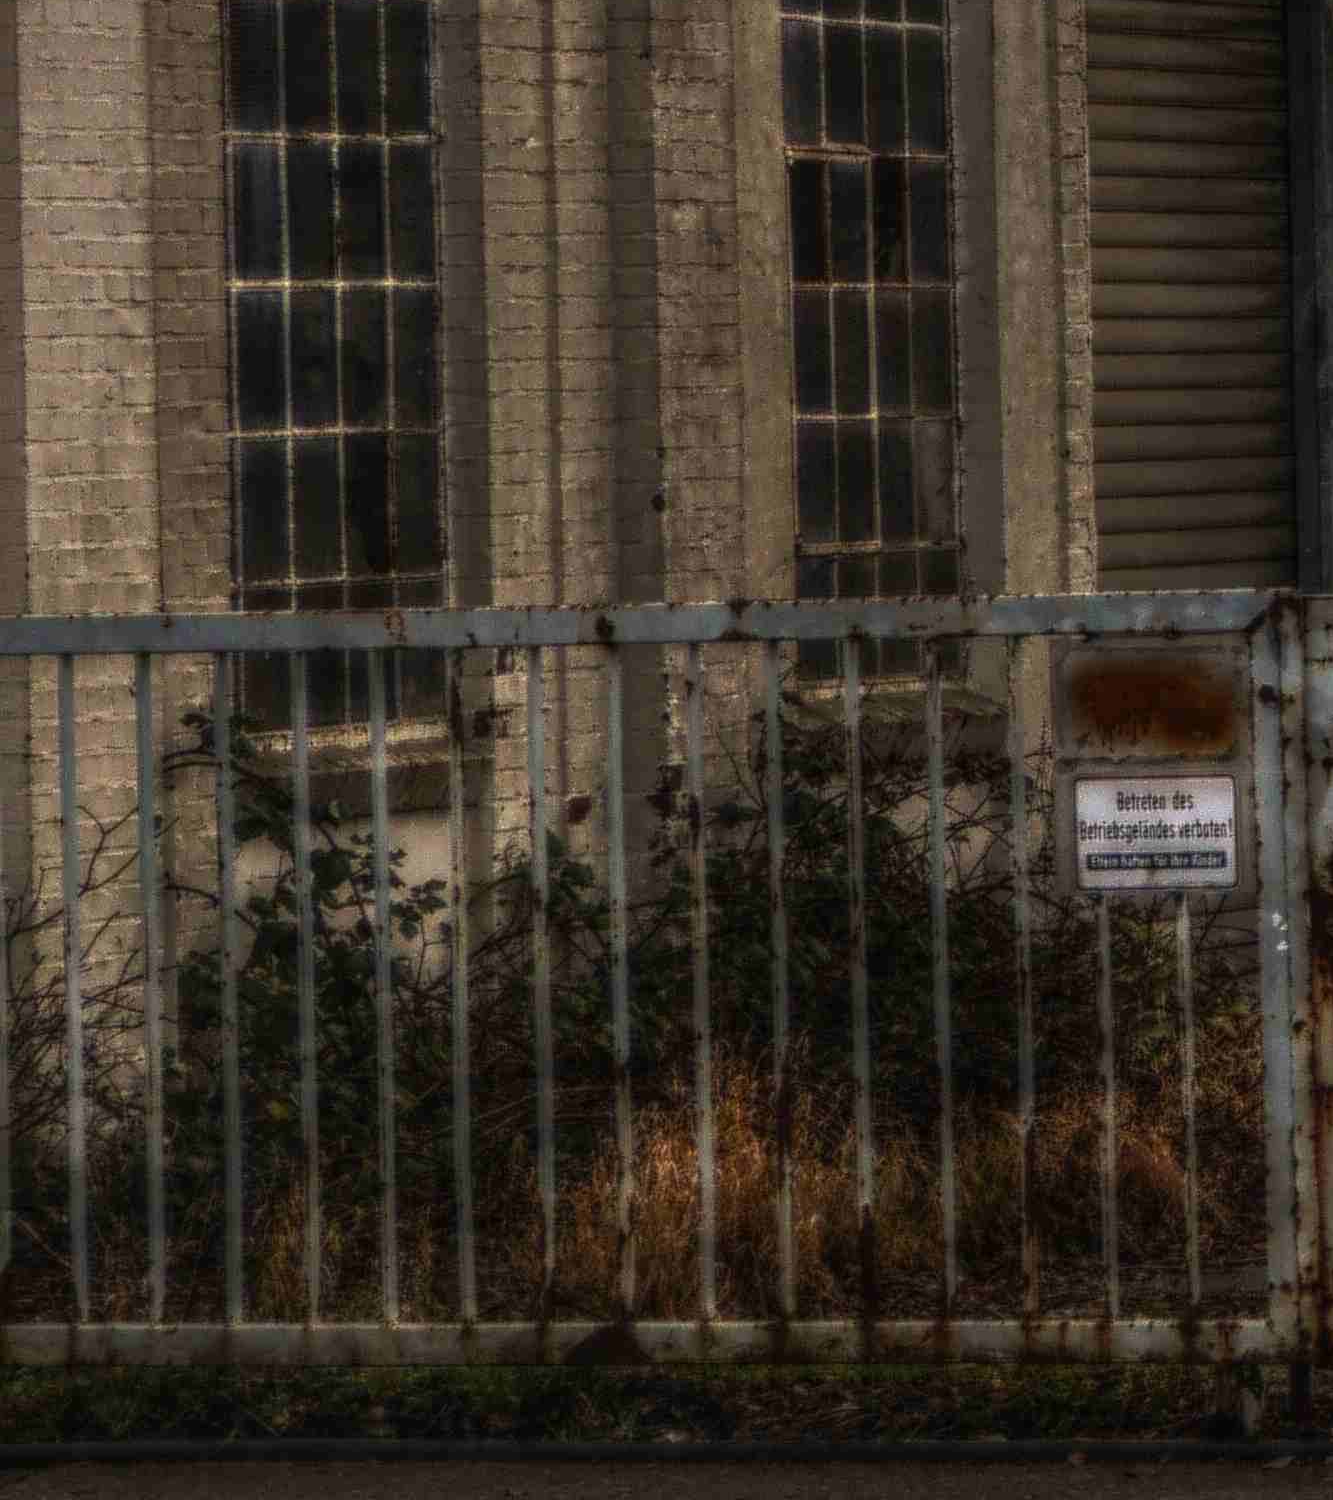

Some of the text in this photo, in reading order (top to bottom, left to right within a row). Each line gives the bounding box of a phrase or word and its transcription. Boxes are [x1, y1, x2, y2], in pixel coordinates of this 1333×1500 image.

[1117, 790, 1194, 811] Betreten des
[1179, 817, 1232, 838] verboten!
